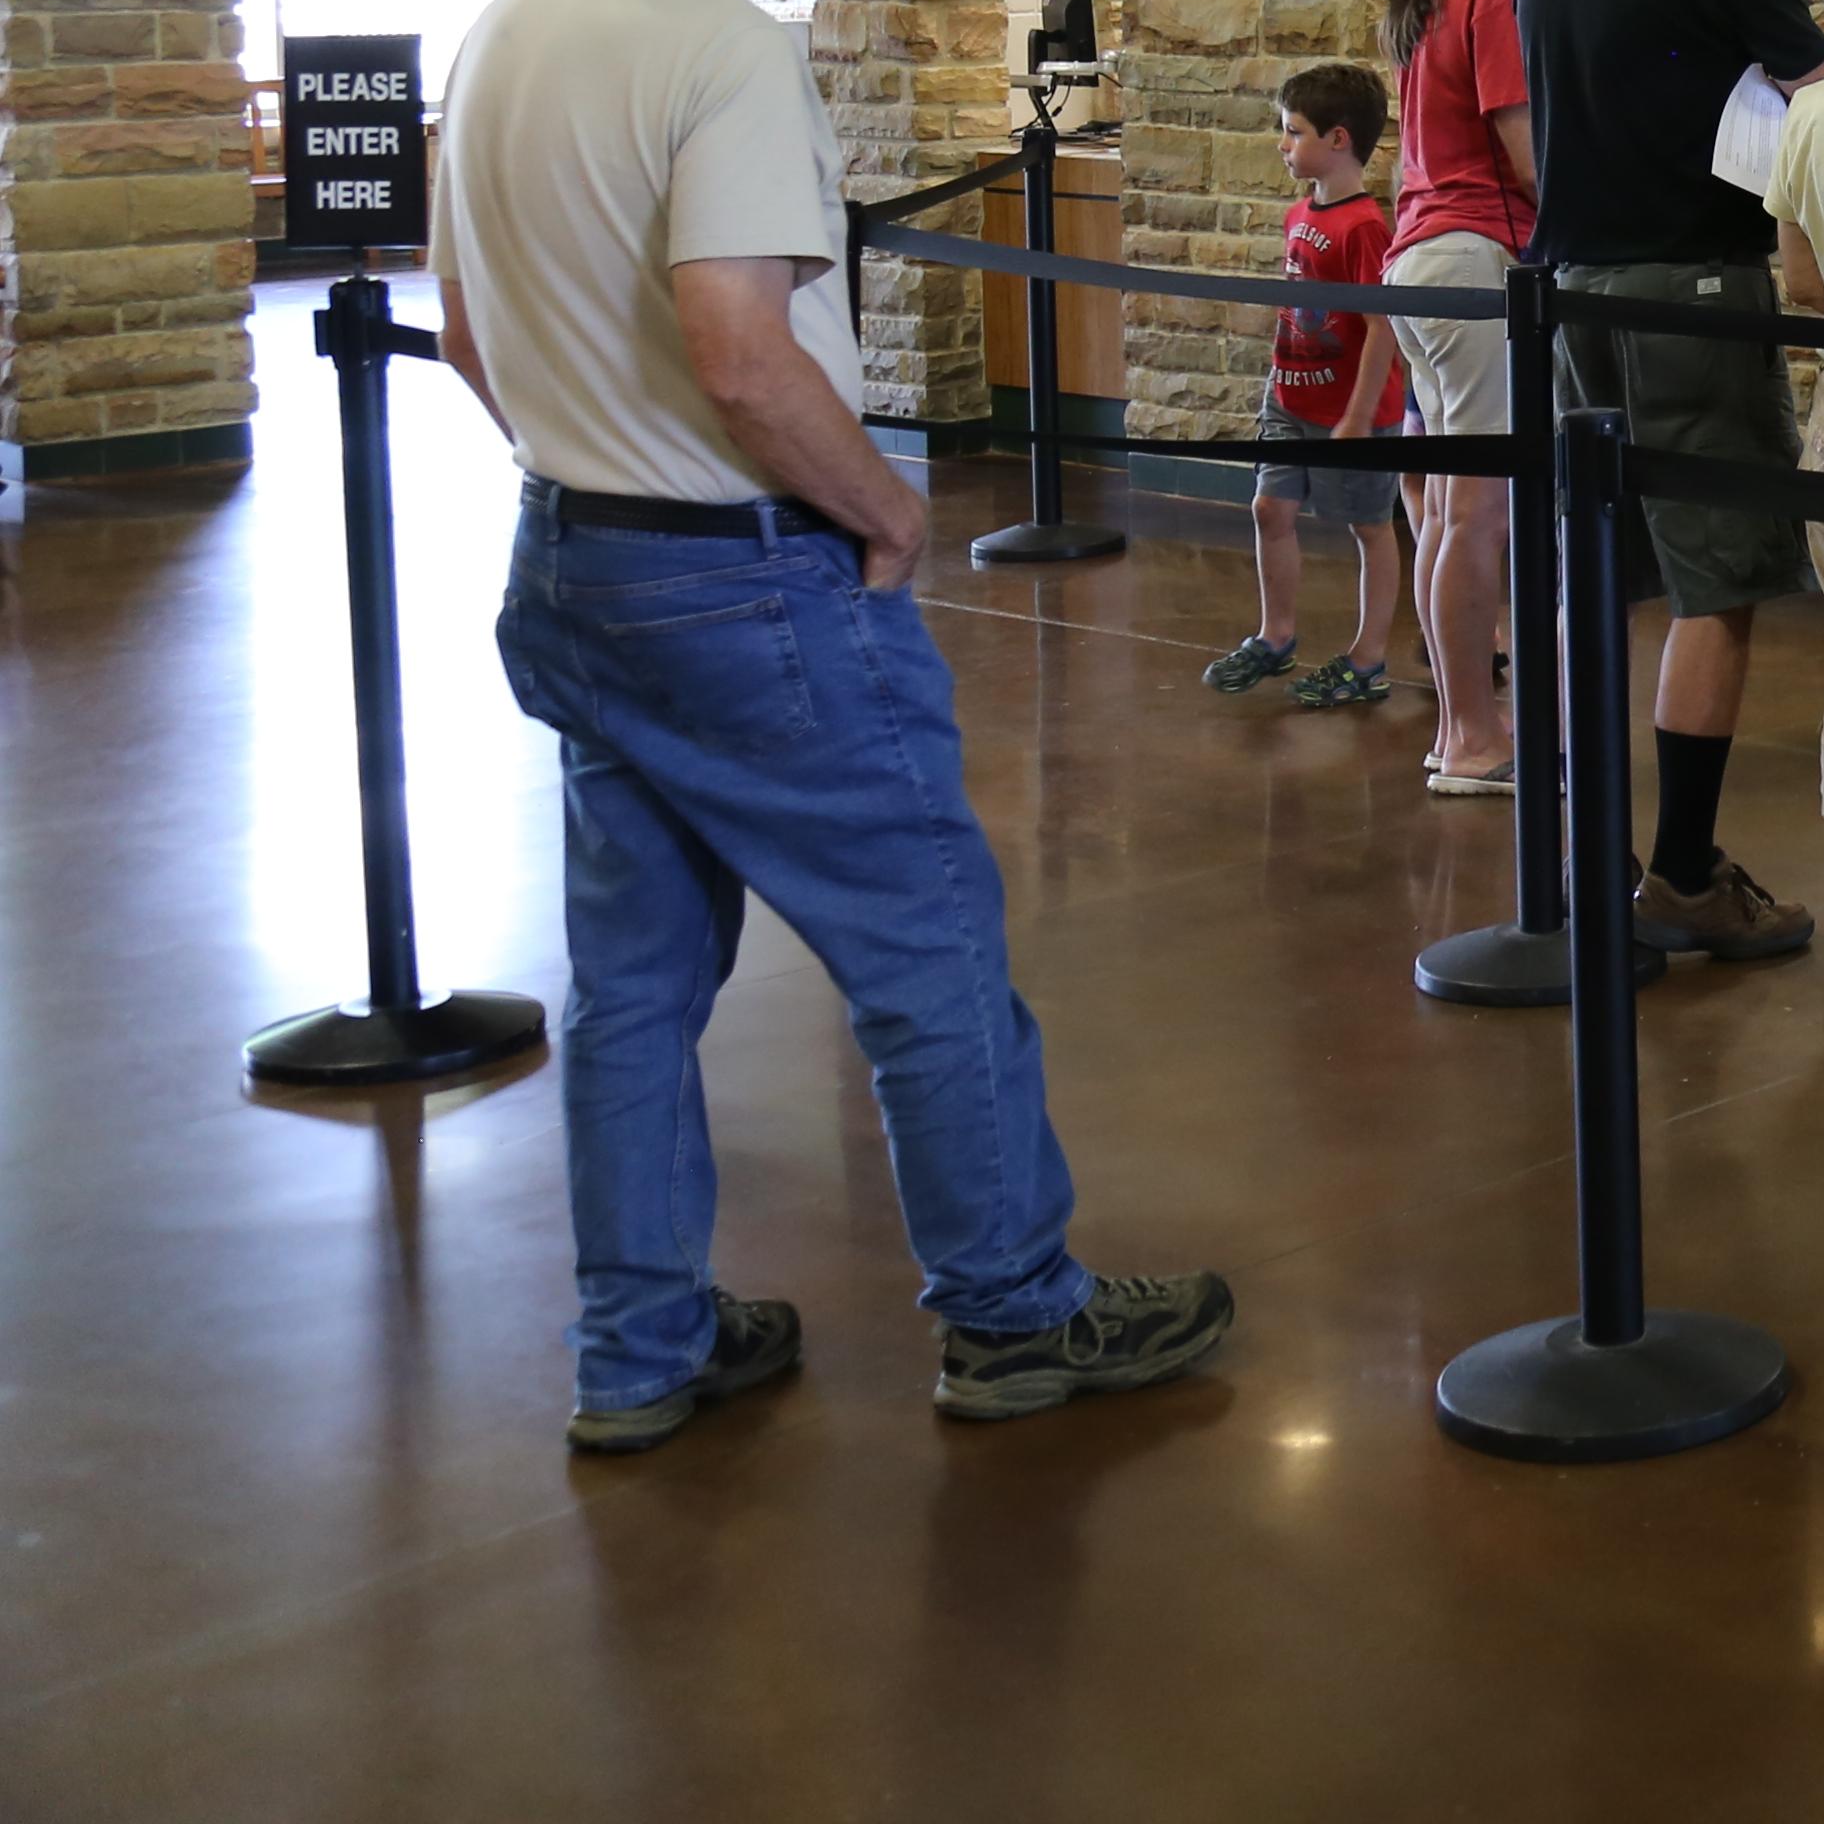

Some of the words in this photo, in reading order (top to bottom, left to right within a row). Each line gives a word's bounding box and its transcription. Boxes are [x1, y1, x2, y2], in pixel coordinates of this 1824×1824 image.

[297, 71, 407, 102] PLEASE
[306, 126, 400, 157] ENTER
[315, 180, 392, 210] HERE
